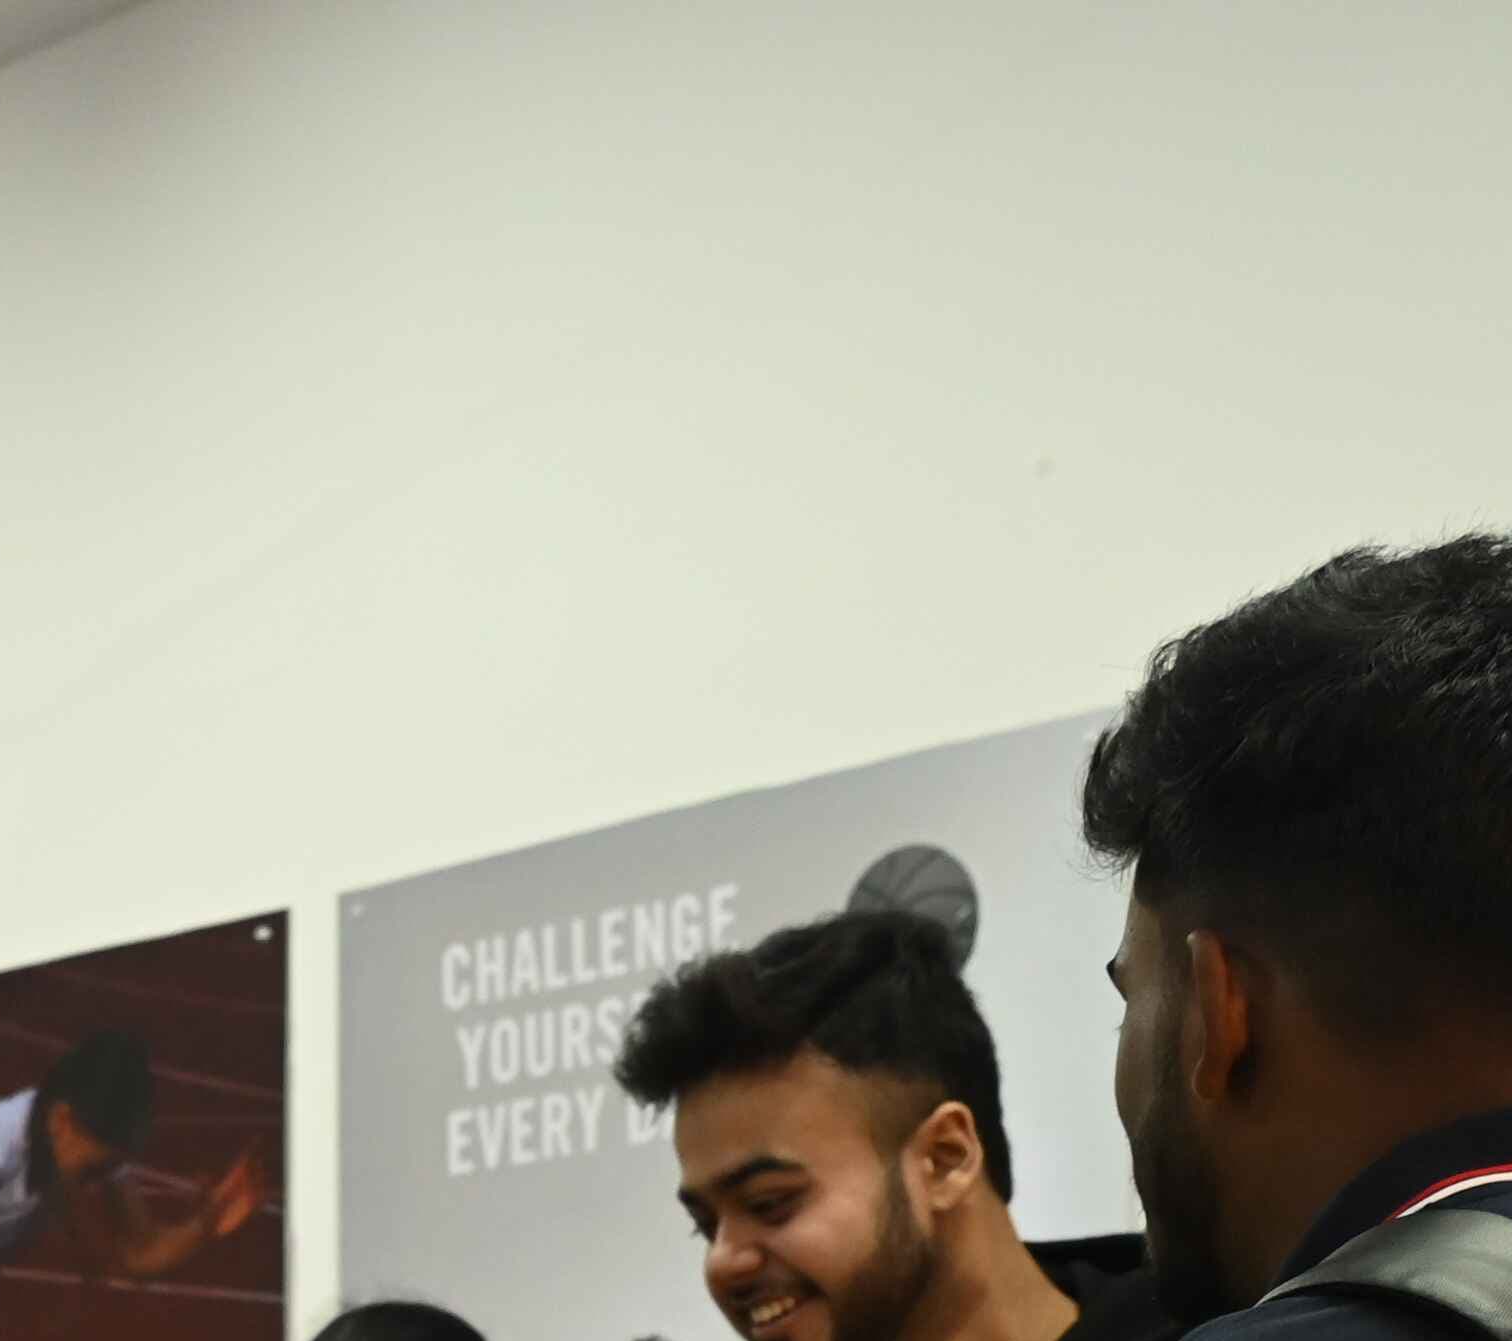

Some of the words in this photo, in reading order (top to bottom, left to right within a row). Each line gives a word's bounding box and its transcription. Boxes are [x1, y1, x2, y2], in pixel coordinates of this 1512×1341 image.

[441, 882, 738, 1011] CHALLENGE
[457, 989, 652, 1091] YOURS
[446, 1084, 606, 1177] EVERY
